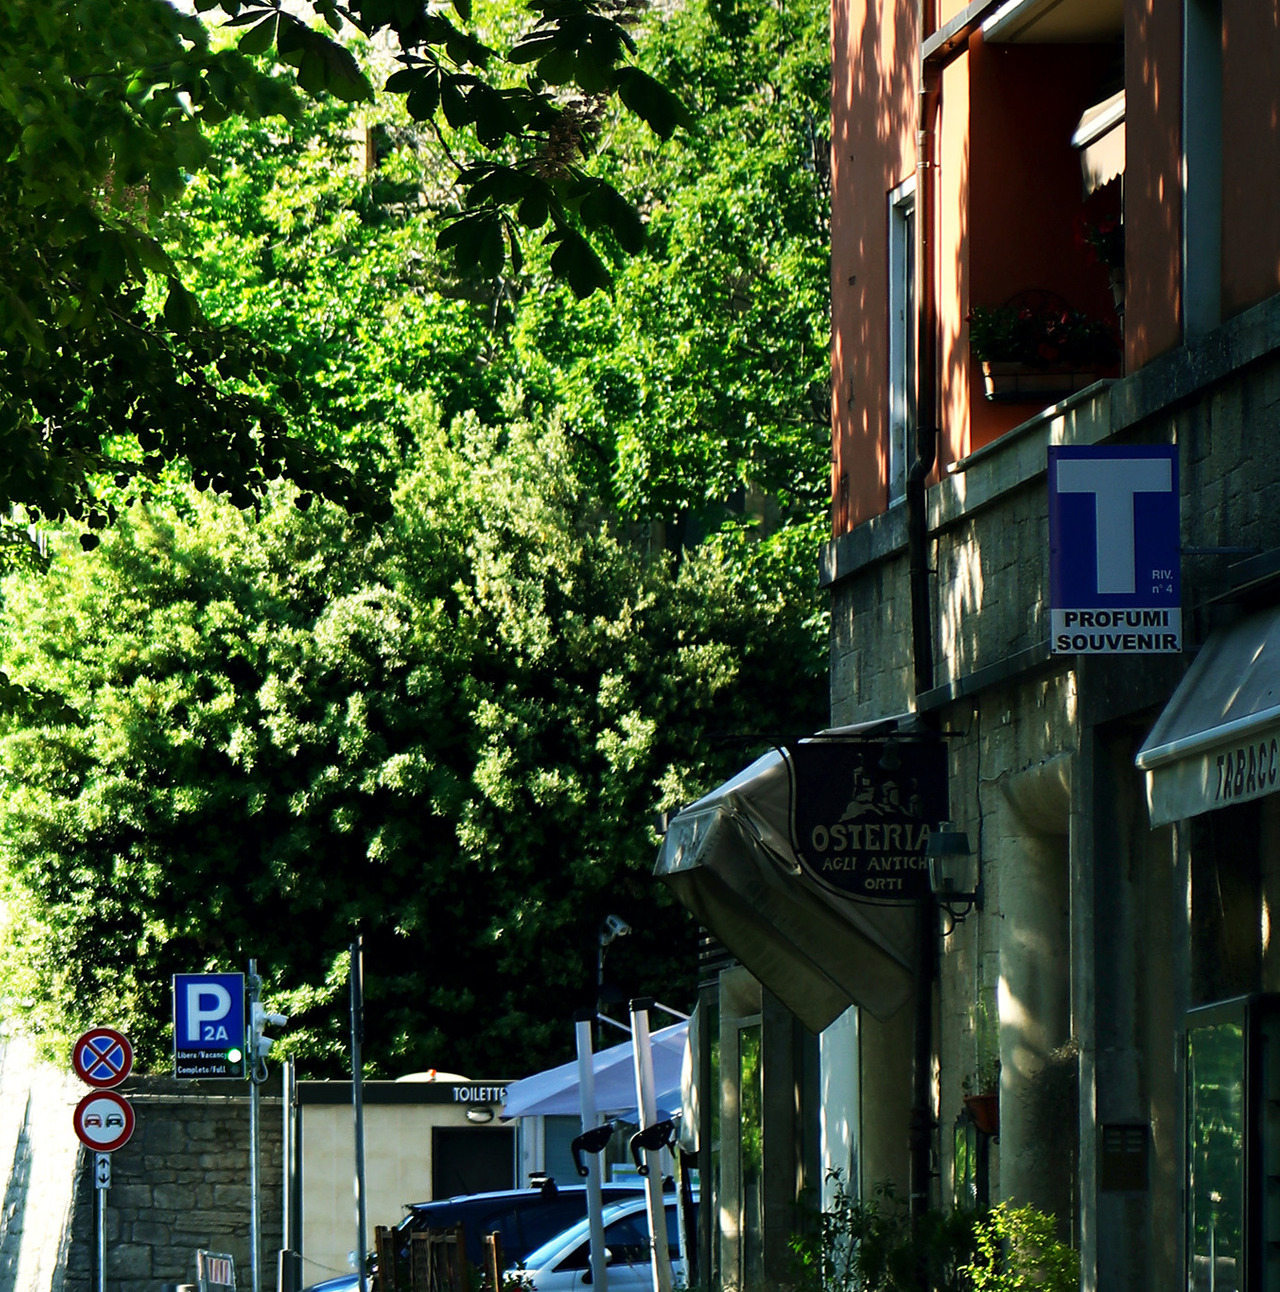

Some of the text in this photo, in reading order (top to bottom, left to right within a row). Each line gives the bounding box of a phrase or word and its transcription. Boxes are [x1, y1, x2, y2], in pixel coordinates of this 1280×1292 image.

[1057, 458, 1172, 594] T
[1152, 570, 1174, 580] RIV.
[1166, 584, 1174, 594] 4
[1064, 611, 1169, 628] PROFUMI
[1057, 634, 1177, 651] SOUVENIR
[811, 823, 933, 852] OSTERIA
[822, 856, 929, 871] AGLI ANTICH
[864, 877, 903, 891] ORTI
[187, 983, 232, 1041] P
[204, 1025, 229, 1041] 2A
